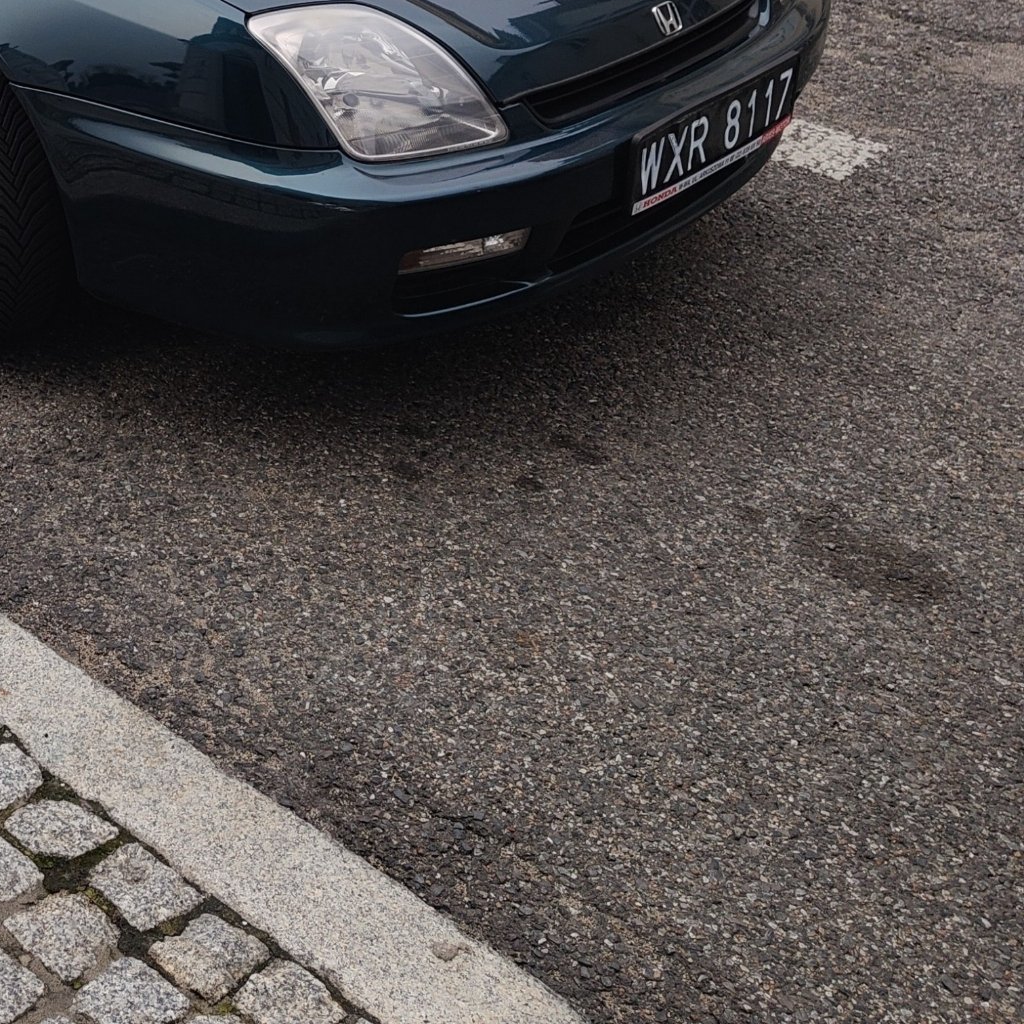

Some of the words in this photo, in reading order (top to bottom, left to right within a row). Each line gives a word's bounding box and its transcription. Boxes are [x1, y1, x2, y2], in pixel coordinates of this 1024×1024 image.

[640, 115, 709, 196] WXR
[724, 67, 794, 150] 8117
[642, 186, 677, 208] HONDA
